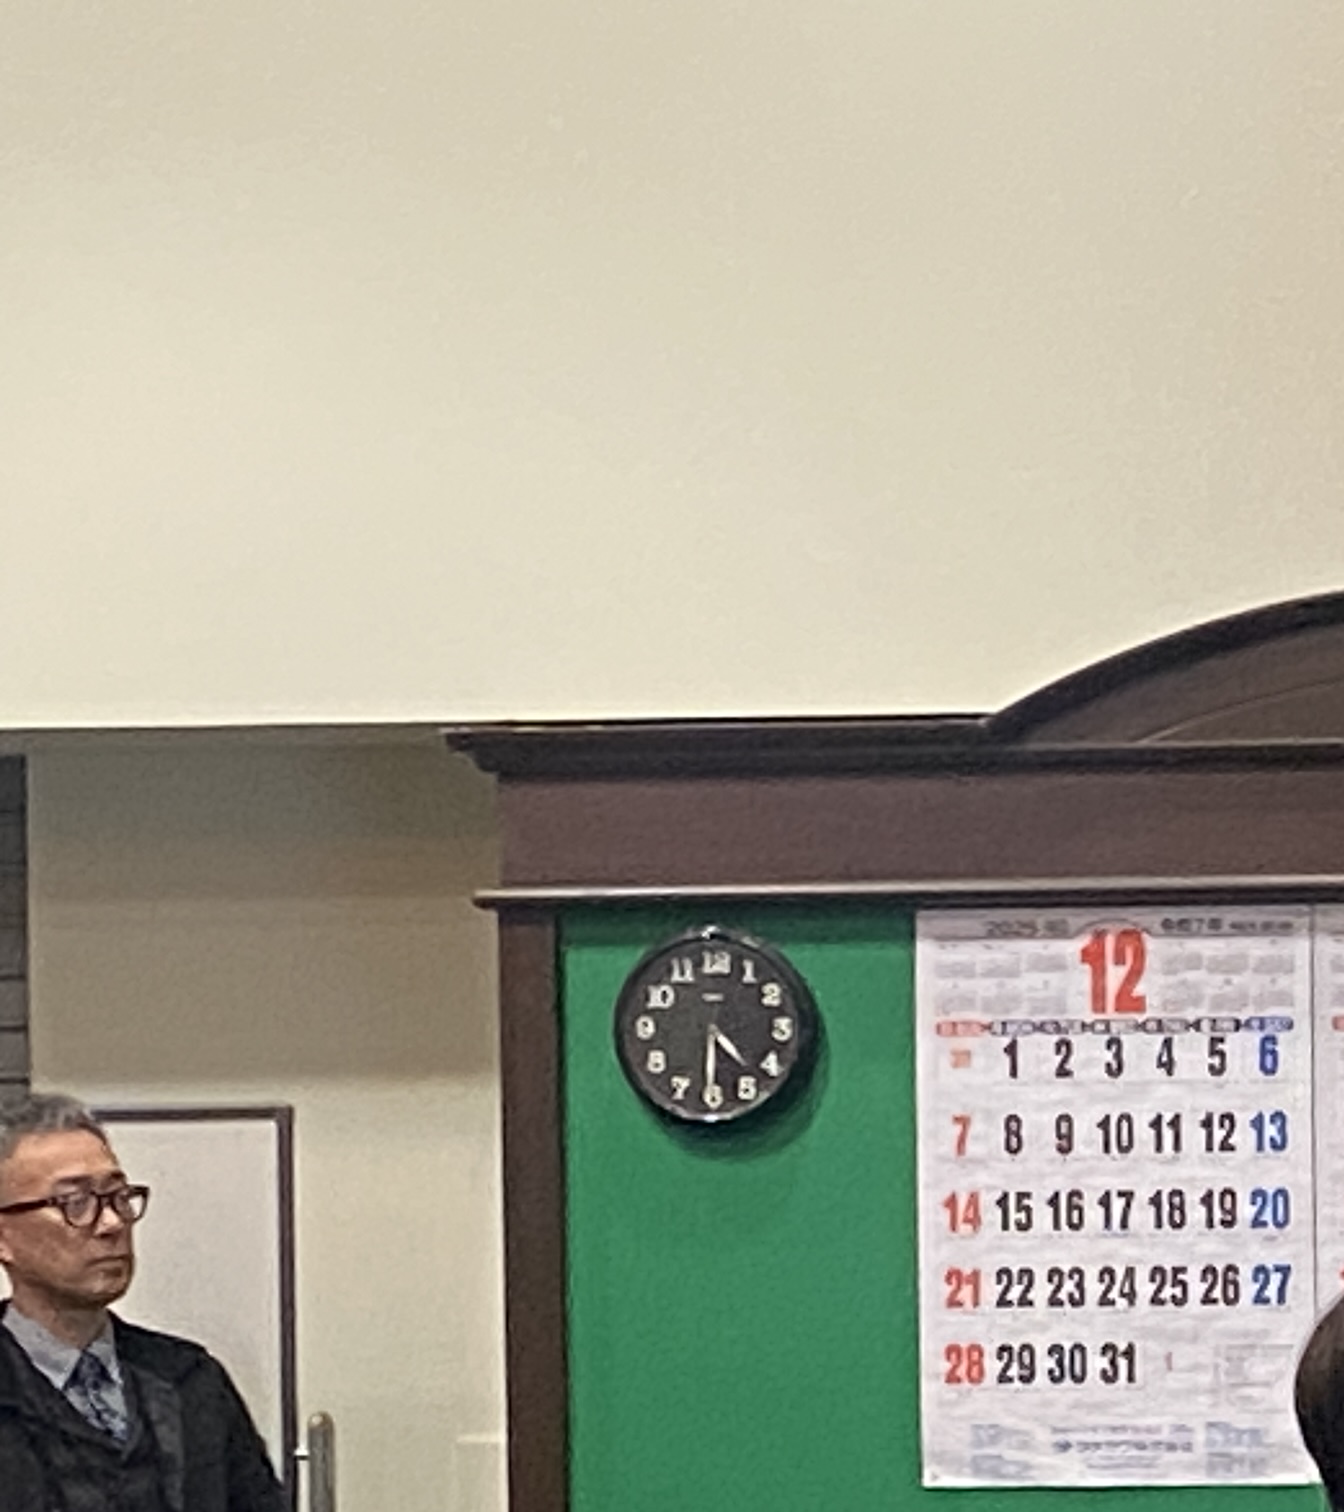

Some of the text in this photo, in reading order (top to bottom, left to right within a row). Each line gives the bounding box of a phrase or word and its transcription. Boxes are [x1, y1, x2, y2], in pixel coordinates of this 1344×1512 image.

[670, 957, 695, 982] 11
[701, 951, 731, 974] 12
[742, 959, 757, 982] 1
[1079, 928, 1147, 1014] 12
[647, 985, 675, 1009] 10
[761, 983, 781, 1007] 2
[635, 1015, 655, 1040] 9
[771, 1017, 793, 1041] 3
[647, 1050, 666, 1073] 8
[760, 1050, 780, 1077] 4
[1003, 1036, 1018, 1080] 1
[1054, 1037, 1074, 1079] 2
[1104, 1035, 1124, 1079] 3
[1156, 1036, 1176, 1077] 4
[1207, 1035, 1227, 1077] 5
[1259, 1033, 1279, 1077] 6
[670, 1076, 690, 1100] 7
[703, 1084, 723, 1109] 6
[737, 1076, 757, 1100] 5
[952, 1110, 1288, 1158] 7 8 9 10 11 12 13
[943, 1187, 1290, 1233] 14 15 16 17 18 19 20
[944, 1263, 1292, 1309] 21 22 23 24 25 26 27
[944, 1343, 985, 1385] 28
[995, 1343, 1036, 1385] 29
[1047, 1342, 1088, 1385] 30
[1100, 1342, 1136, 1385] 31
